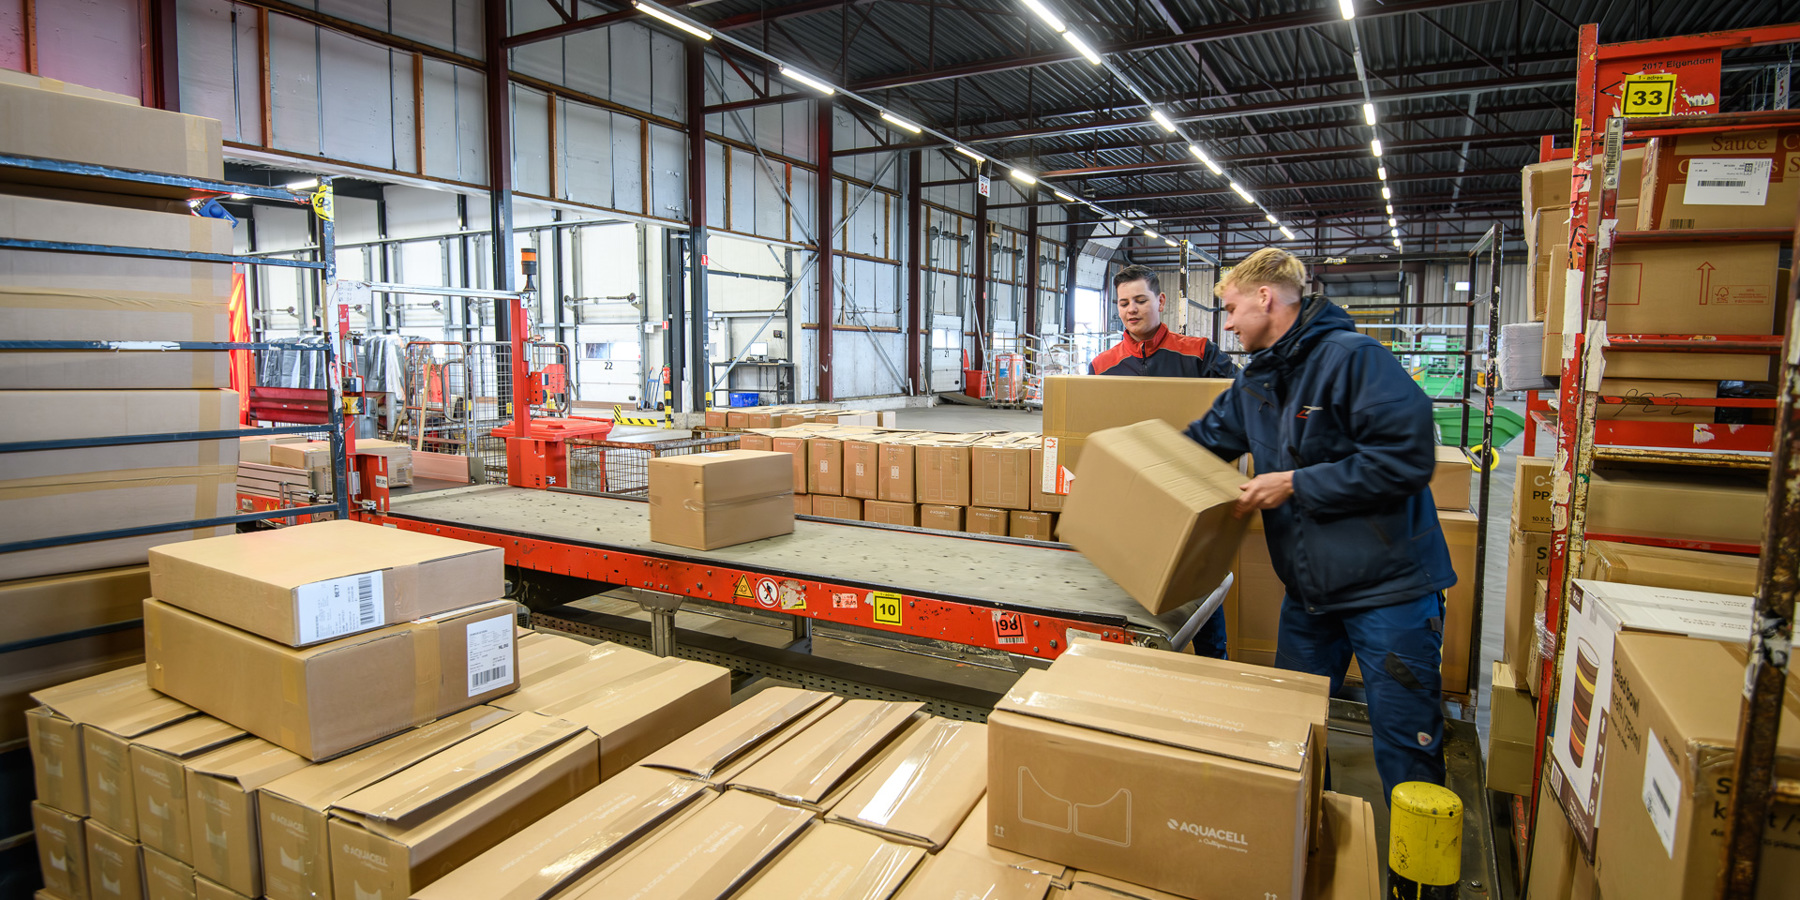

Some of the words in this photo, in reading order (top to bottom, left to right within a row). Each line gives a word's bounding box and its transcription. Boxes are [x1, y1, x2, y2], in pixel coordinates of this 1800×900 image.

[1642, 62, 1664, 70] 2017
[1632, 90, 1663, 106] 33
[1711, 135, 1768, 152] Sauce
[604, 362, 613, 370] 22
[880, 604, 896, 616] 10
[1000, 620, 1018, 631] 98
[1180, 822, 1248, 846] AQUACELL
[350, 846, 388, 866] AQUACELL
